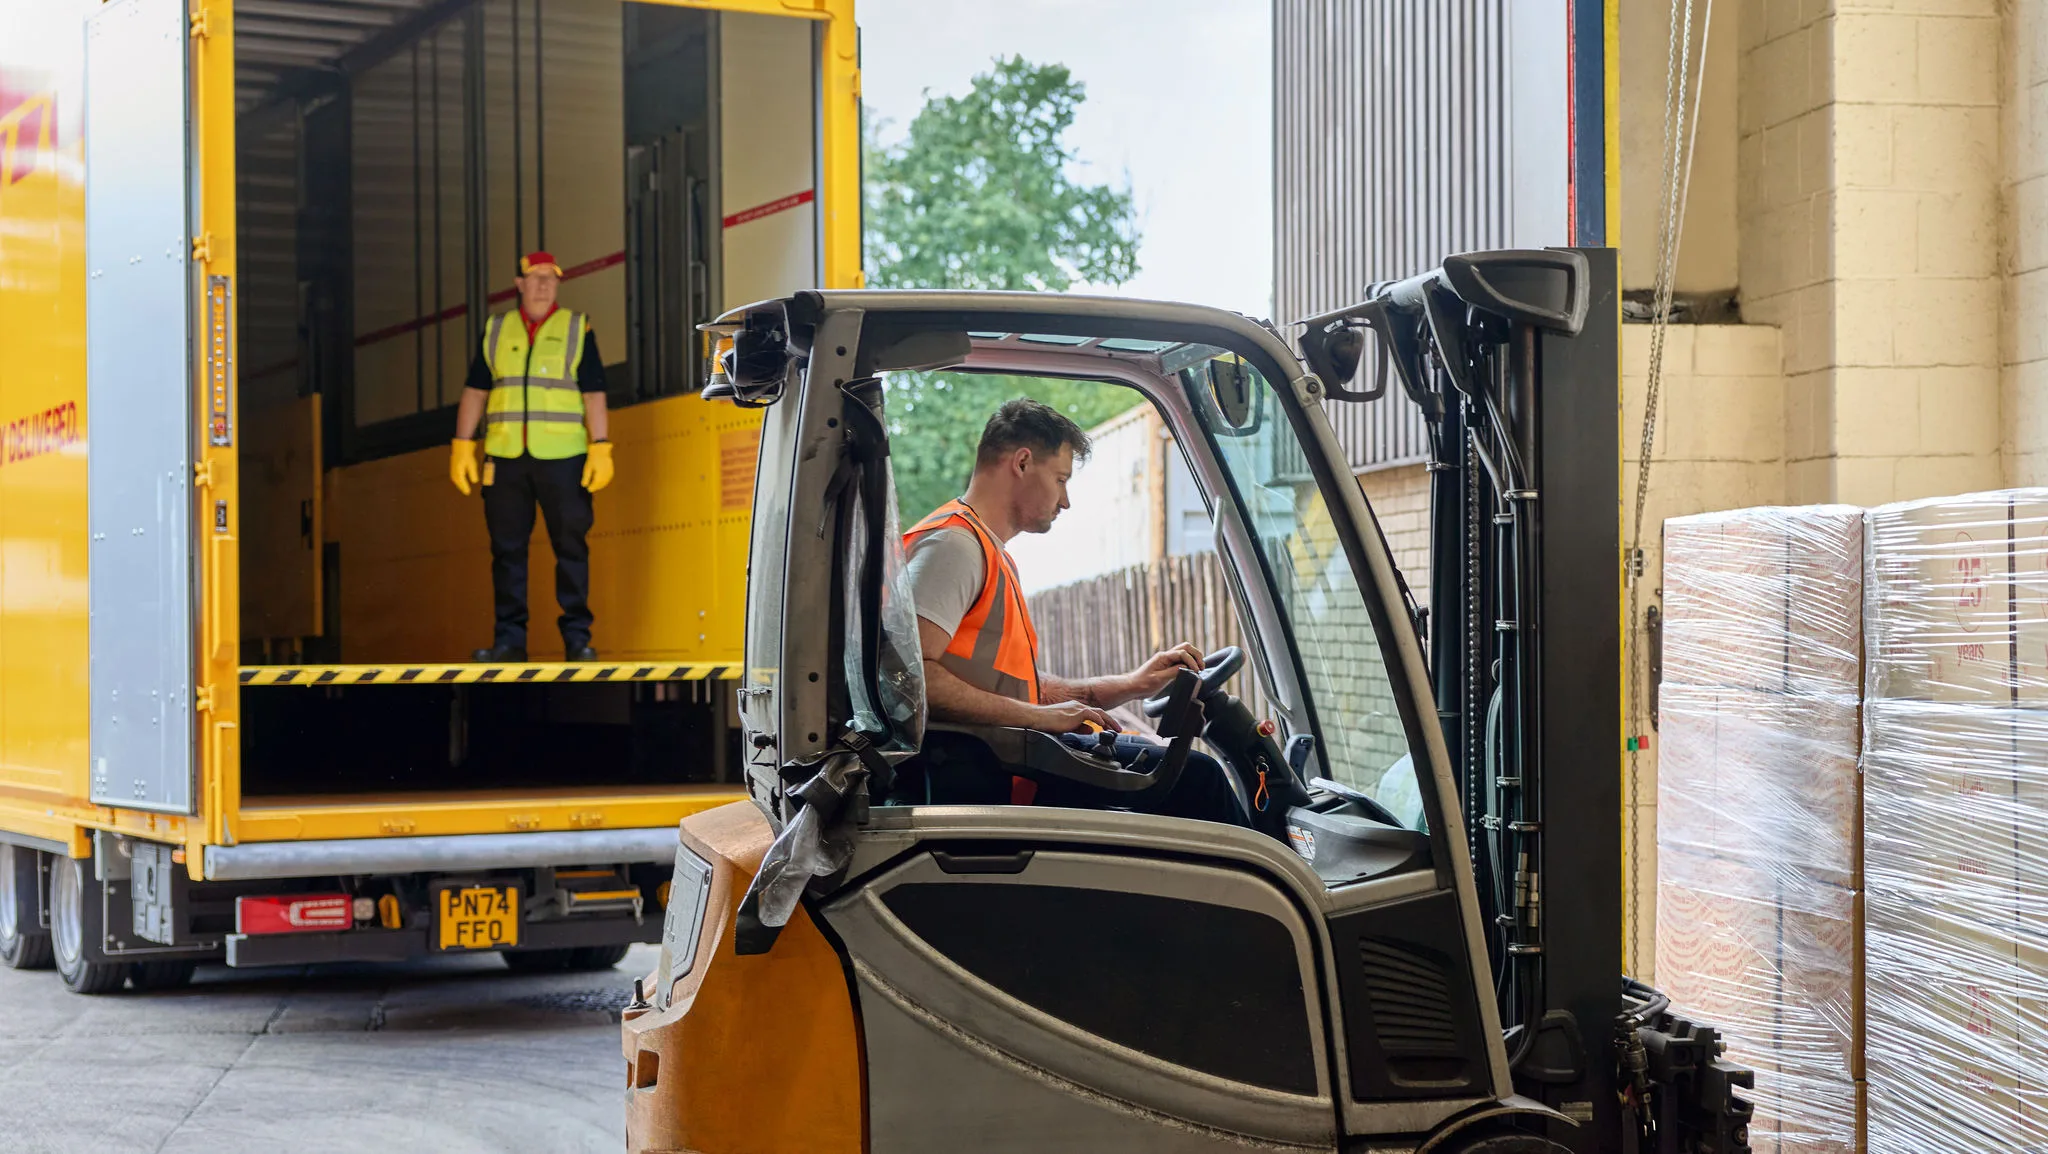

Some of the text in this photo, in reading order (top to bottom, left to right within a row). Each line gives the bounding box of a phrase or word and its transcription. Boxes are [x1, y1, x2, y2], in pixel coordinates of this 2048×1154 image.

[1957, 558, 1982, 607] 25
[1957, 643, 1985, 667] years
[448, 893, 509, 917] PN74
